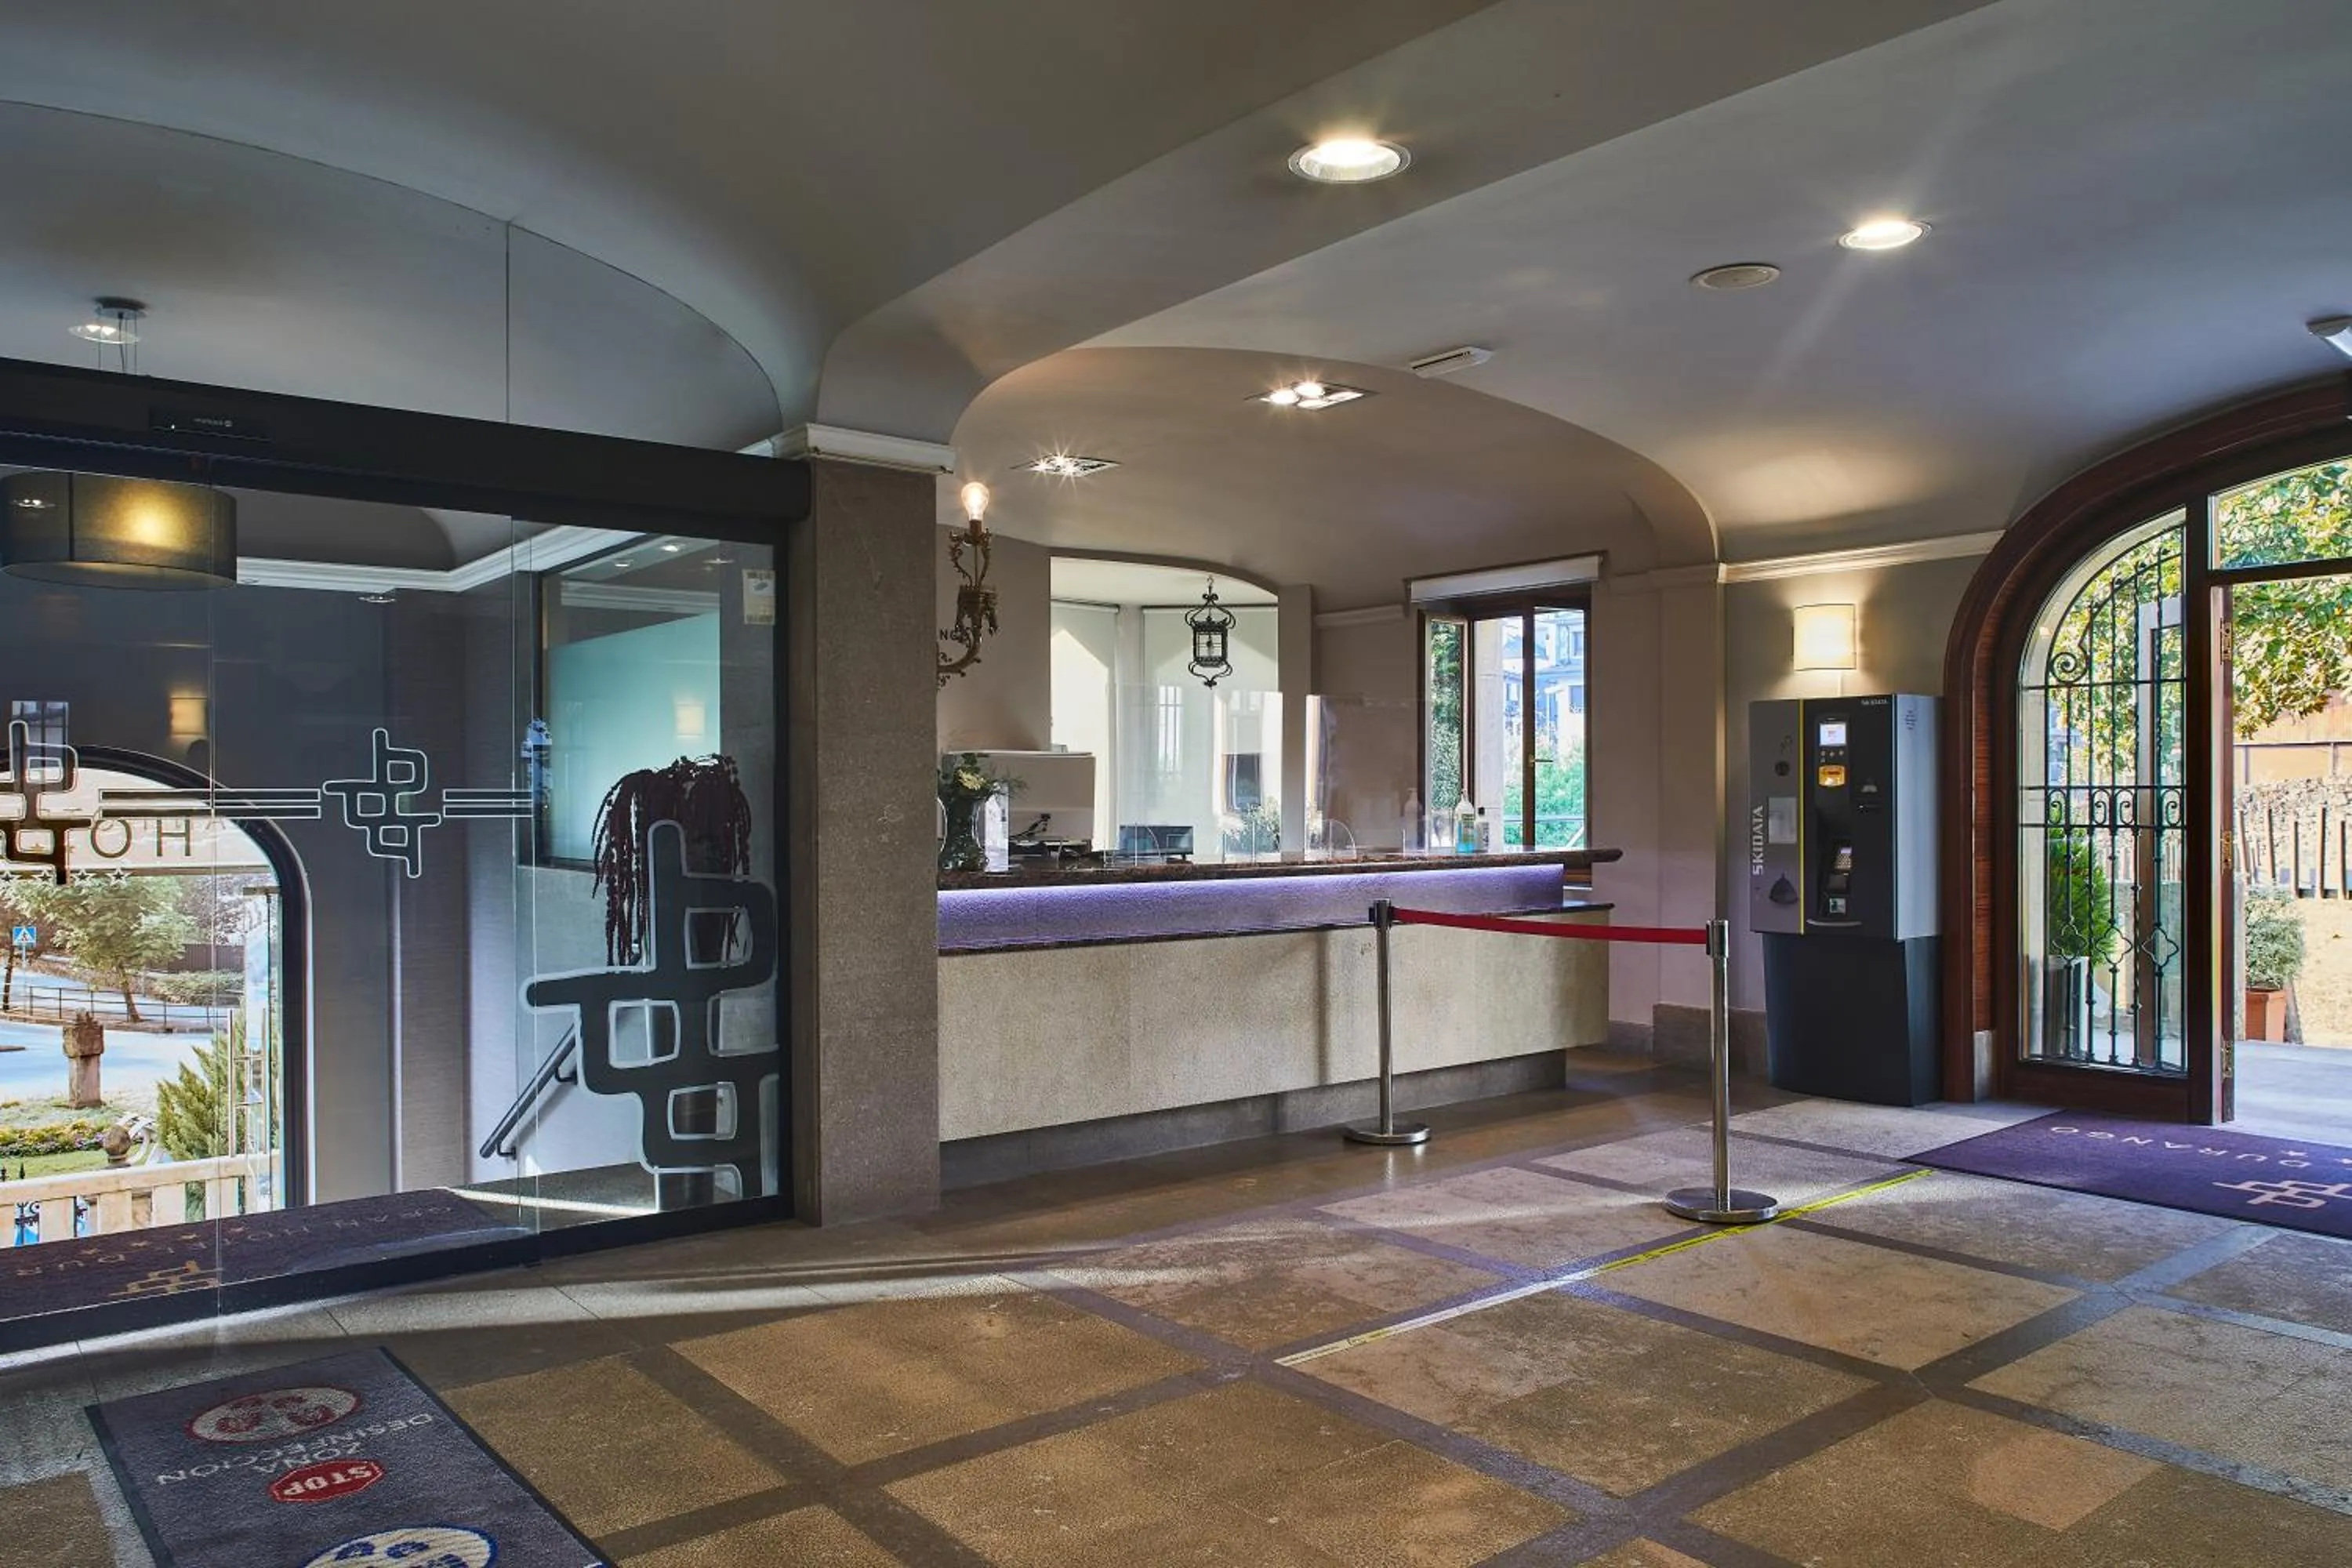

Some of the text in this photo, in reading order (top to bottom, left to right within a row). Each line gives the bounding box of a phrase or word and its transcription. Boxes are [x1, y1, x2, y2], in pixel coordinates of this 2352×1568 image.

[1752, 805, 1763, 875] SKIDATA
[2050, 1126, 2310, 1168] DURANGO
[252, 1441, 359, 1474] ZONA
[282, 1464, 374, 1496] STOP
